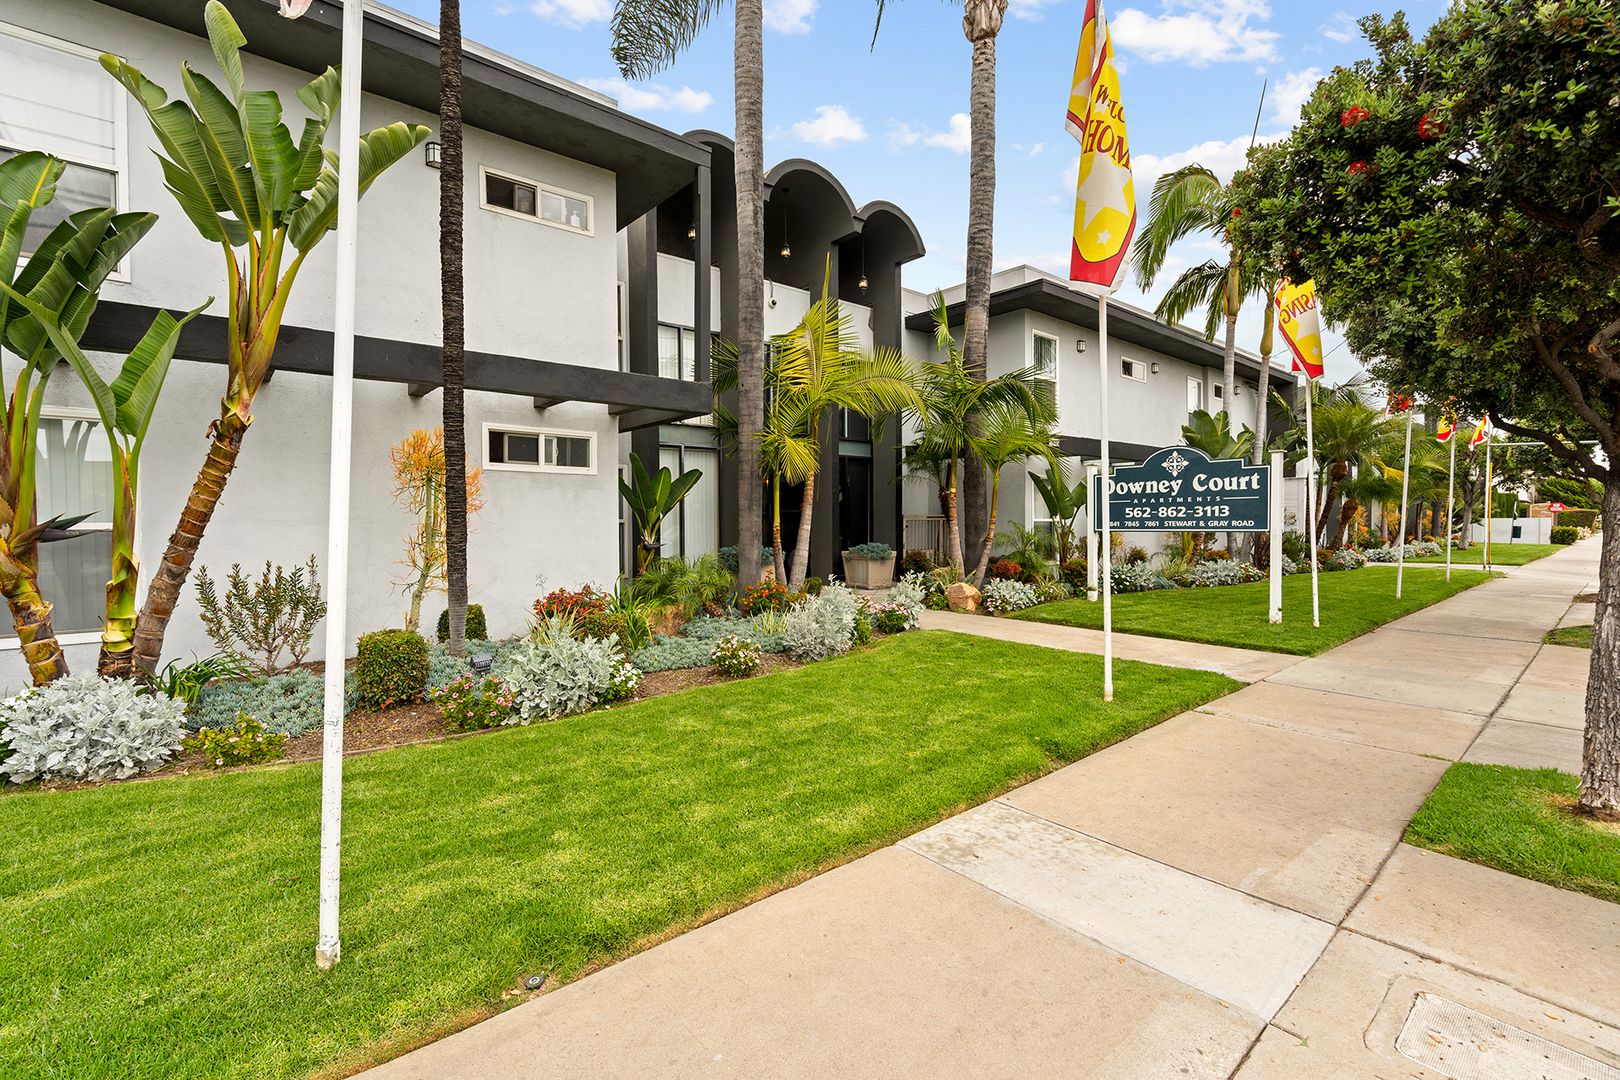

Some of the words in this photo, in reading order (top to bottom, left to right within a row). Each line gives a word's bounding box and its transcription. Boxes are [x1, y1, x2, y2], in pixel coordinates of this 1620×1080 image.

[1083, 119, 1132, 174] HOM
[1192, 472, 1261, 492] Court
[1133, 496, 1221, 504] APARTMENTS
[1125, 505, 1230, 518] 562-862-3113
